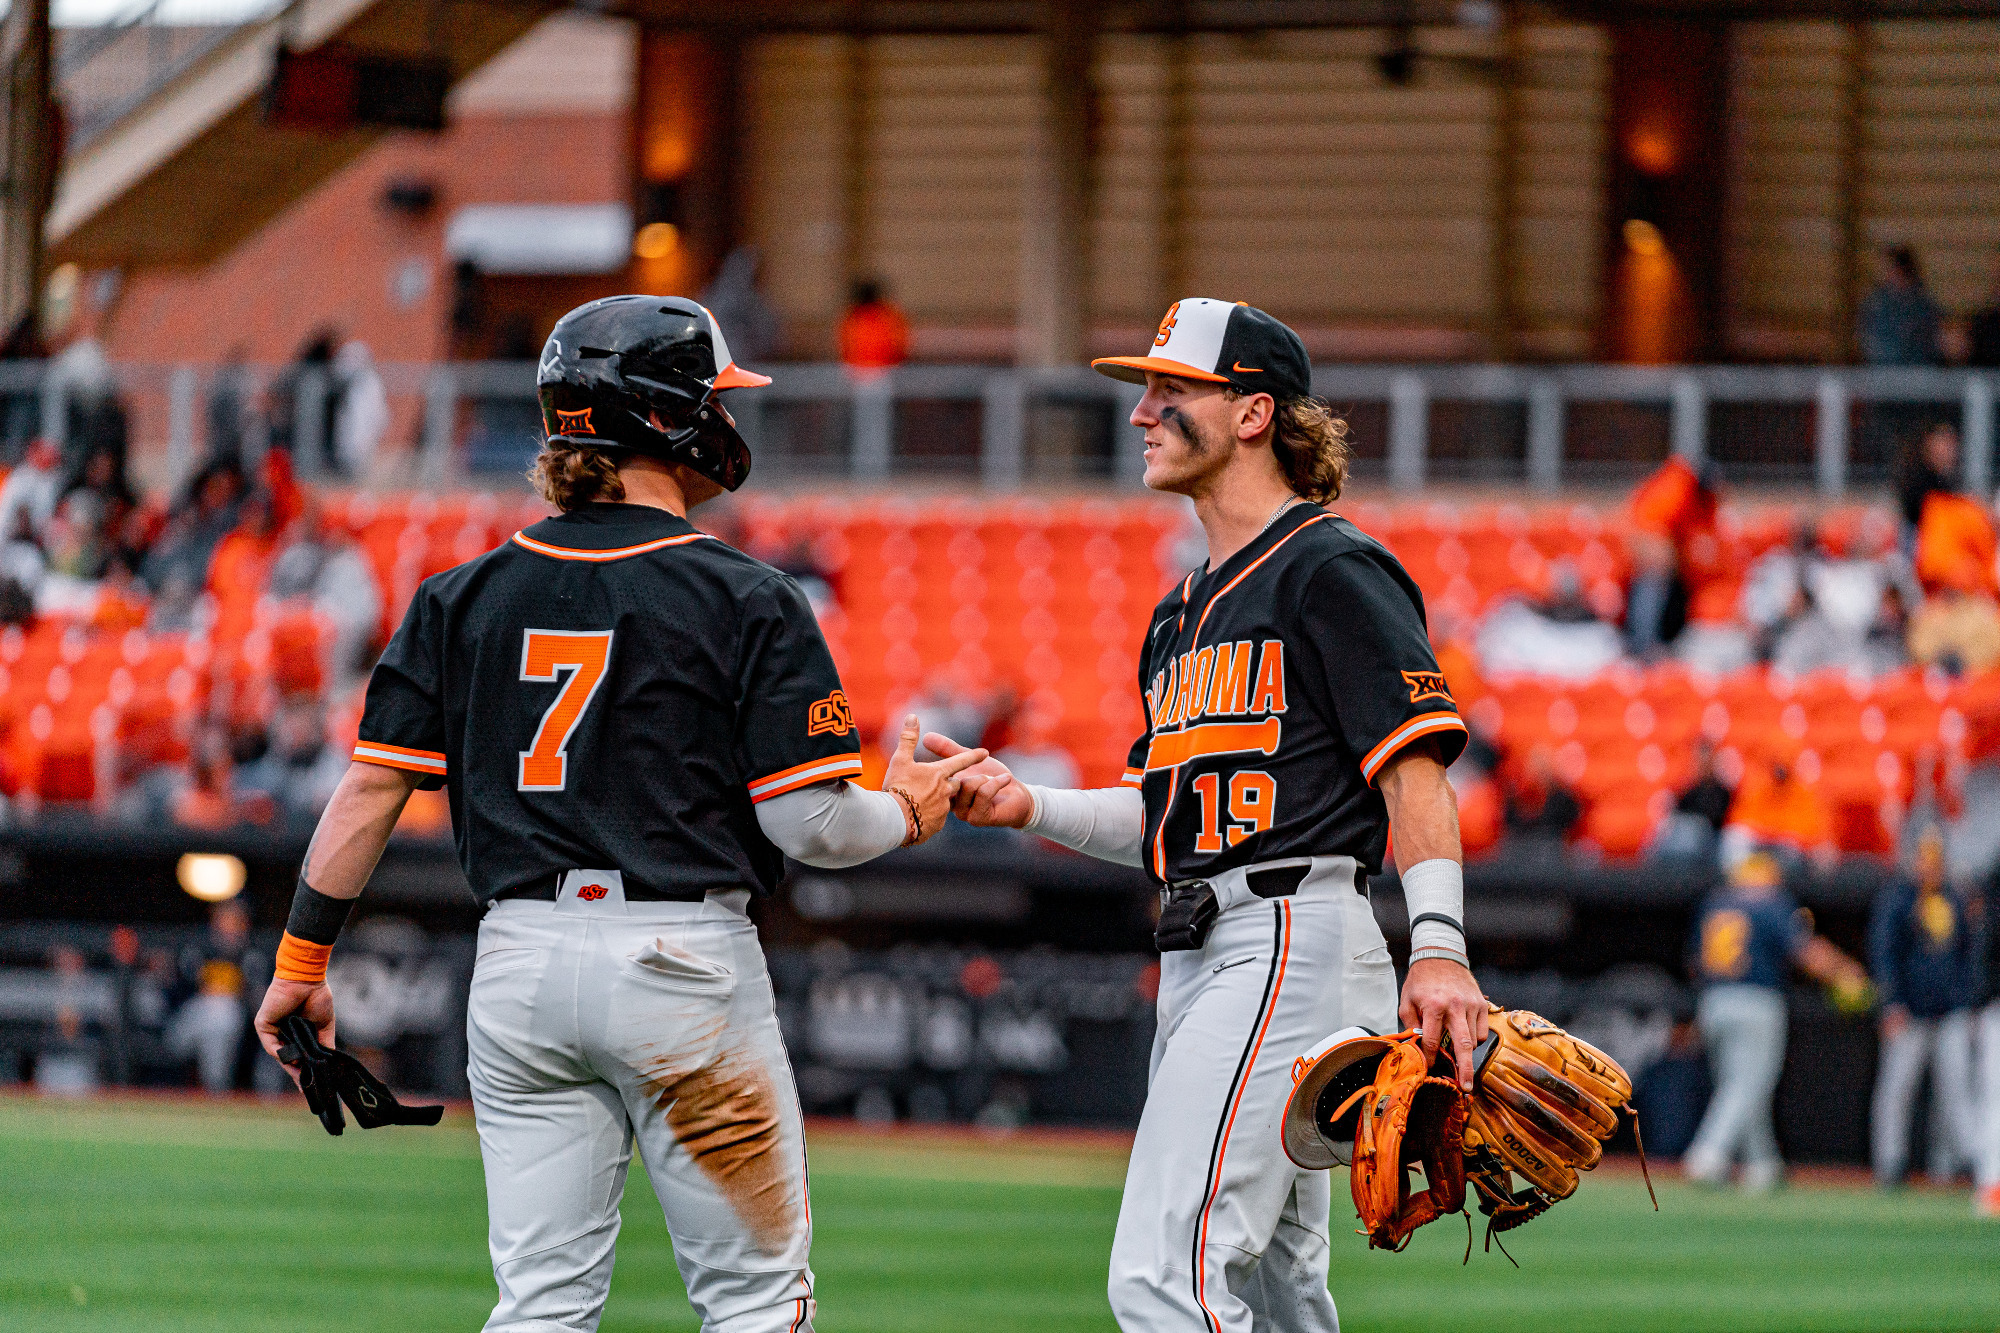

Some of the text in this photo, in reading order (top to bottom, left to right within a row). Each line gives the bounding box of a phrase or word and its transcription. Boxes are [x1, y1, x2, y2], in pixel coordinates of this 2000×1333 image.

[557, 411, 592, 432] XII
[518, 628, 614, 792] 7
[1145, 640, 1289, 730] AHOMA
[1192, 770, 1277, 853] 19
[577, 884, 609, 901] OSU
[1503, 1133, 1547, 1170] A2000
